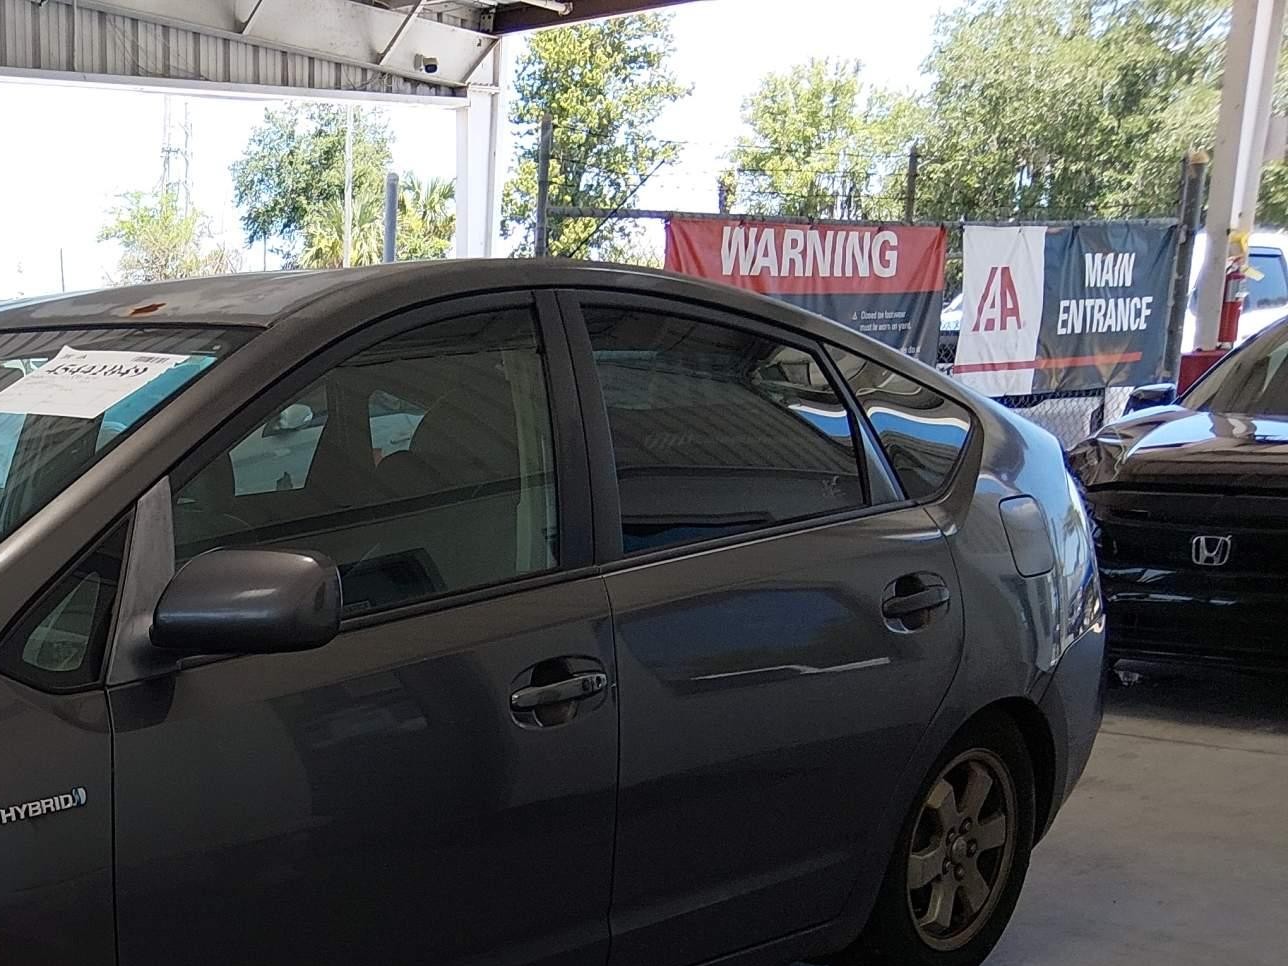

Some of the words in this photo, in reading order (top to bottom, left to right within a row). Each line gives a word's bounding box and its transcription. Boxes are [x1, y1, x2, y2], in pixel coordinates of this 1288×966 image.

[720, 225, 899, 279] WARNING
[1084, 252, 1137, 288] MAIN
[1056, 296, 1154, 335] ENTRANCE
[0, 793, 74, 824] HYBRID
